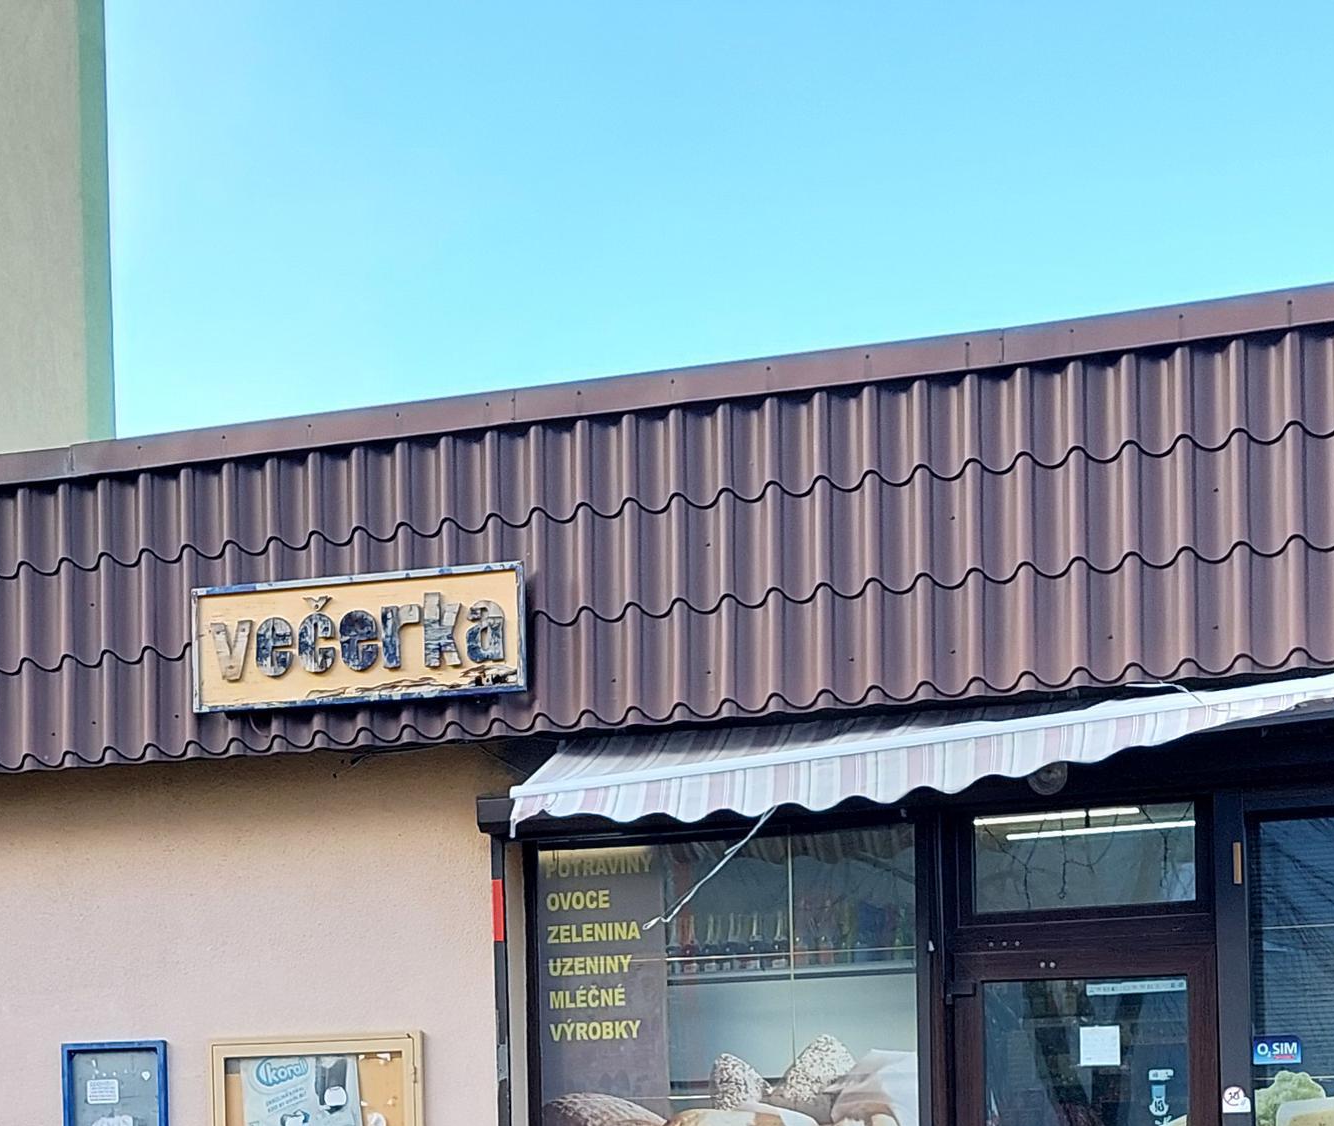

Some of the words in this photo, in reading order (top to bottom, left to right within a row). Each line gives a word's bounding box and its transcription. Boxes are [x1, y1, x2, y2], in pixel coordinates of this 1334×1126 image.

[210, 592, 506, 681] večerka
[546, 854, 652, 878] POTRAVINY
[546, 890, 610, 911] OVOCE
[547, 922, 641, 944] ZELENINA
[548, 955, 632, 976] UZENINY
[549, 984, 626, 1009] MLÉČNÉ
[550, 1019, 641, 1041] VÝROBKY
[1272, 1042, 1297, 1054] SIM
